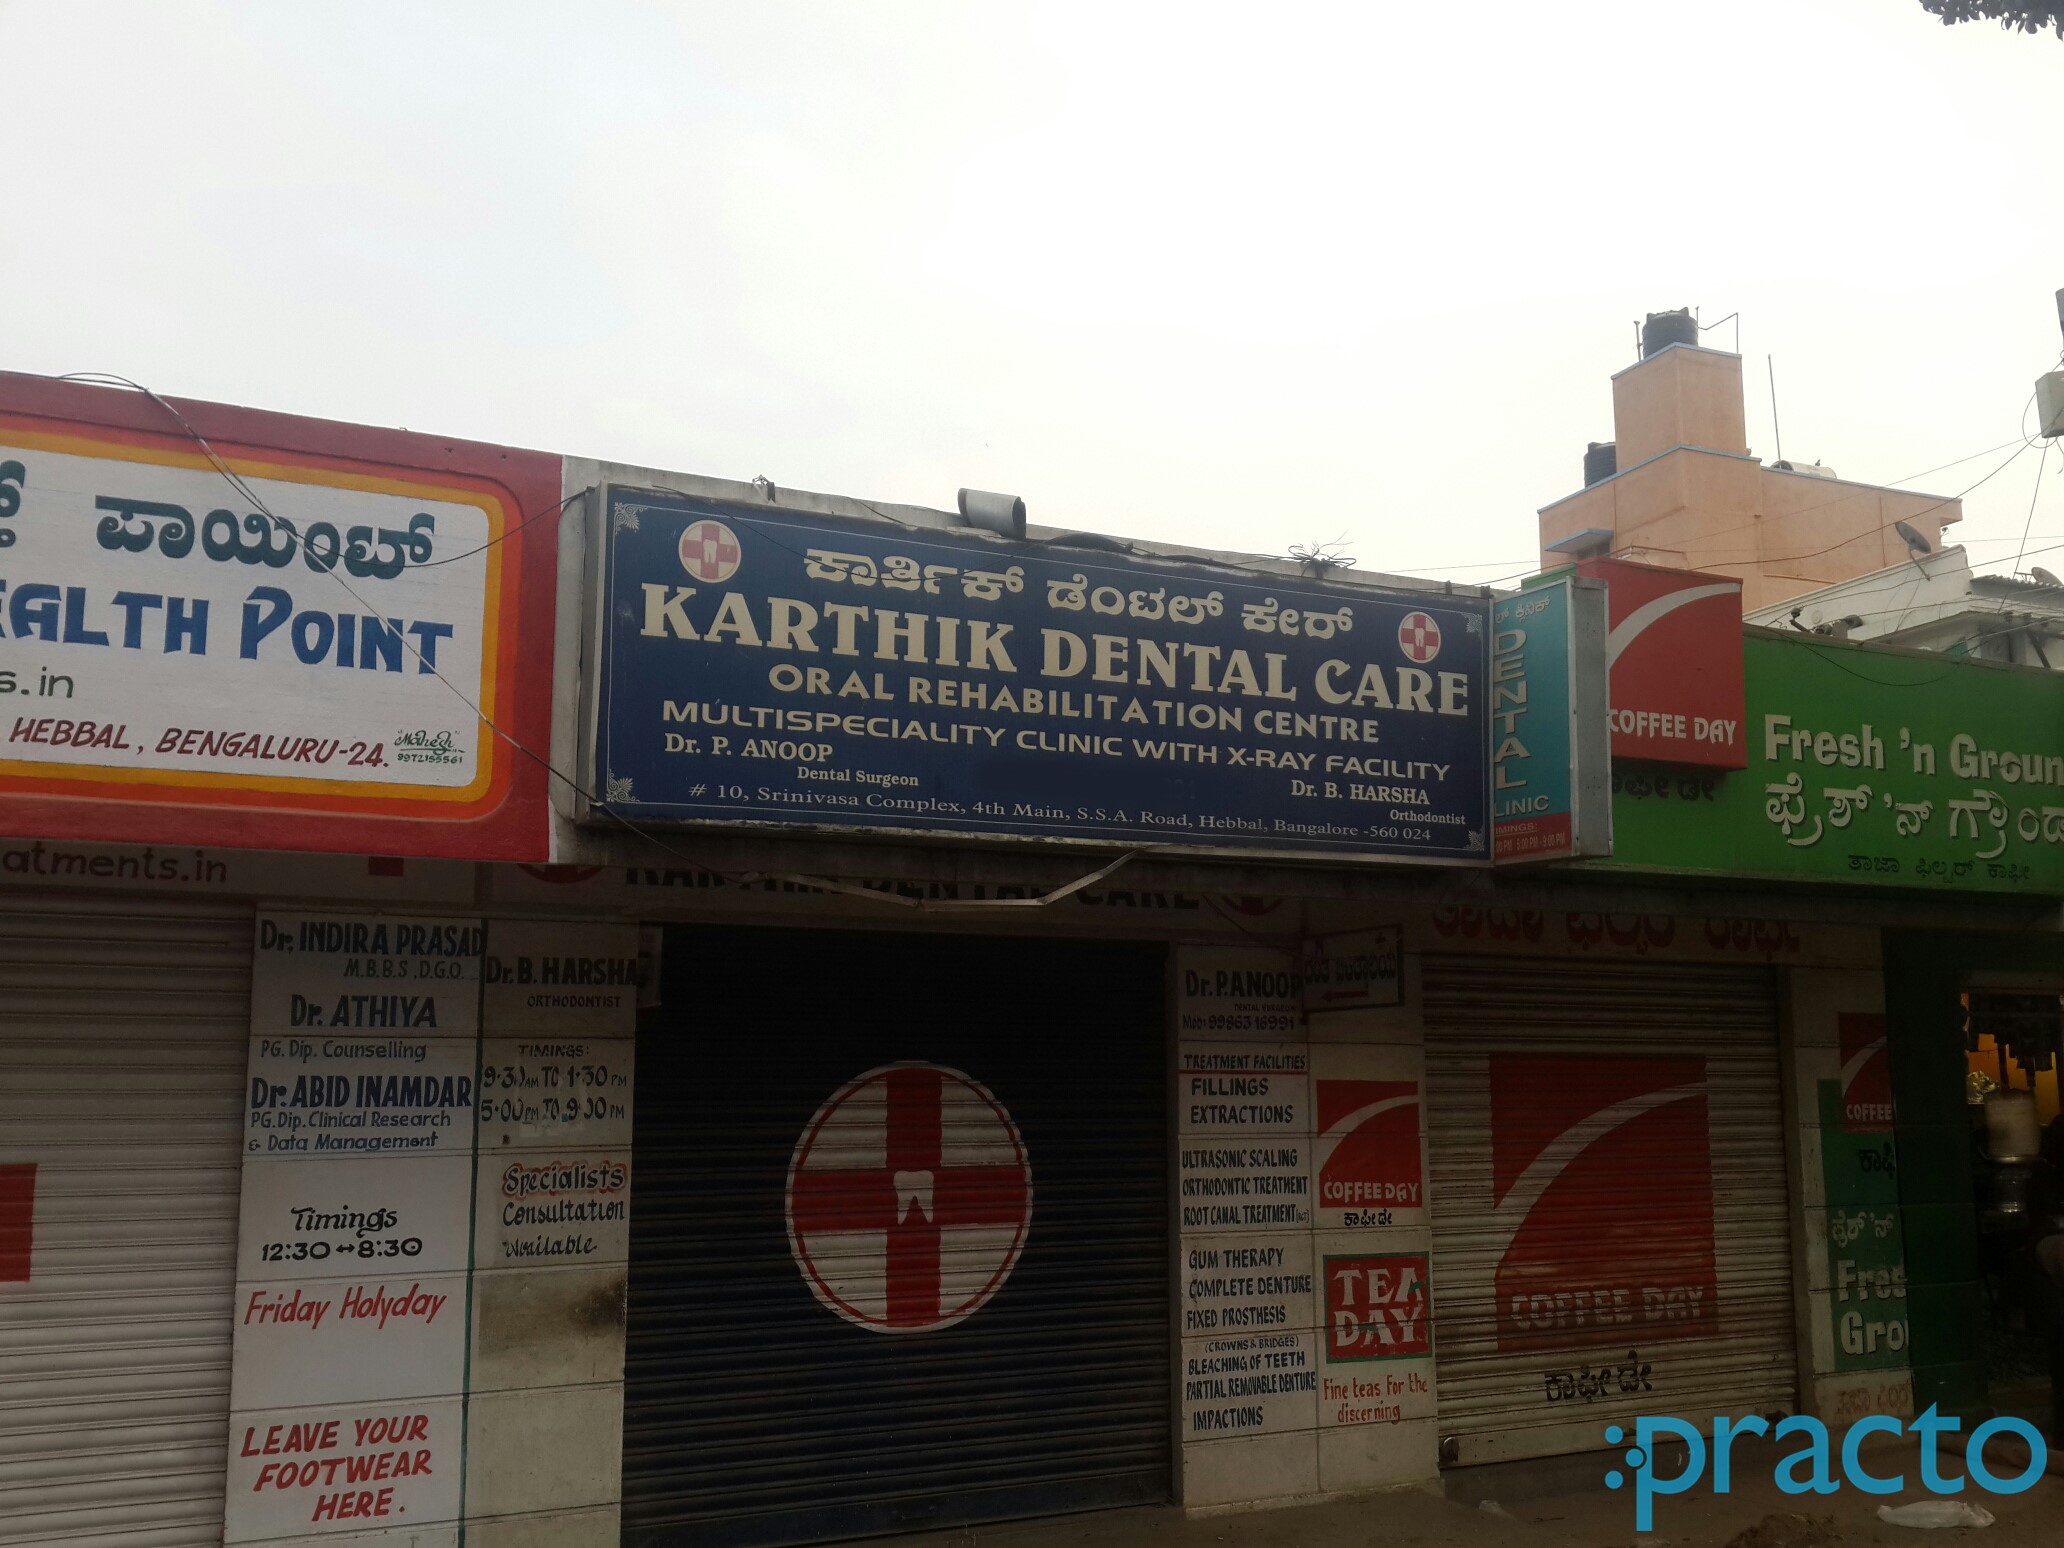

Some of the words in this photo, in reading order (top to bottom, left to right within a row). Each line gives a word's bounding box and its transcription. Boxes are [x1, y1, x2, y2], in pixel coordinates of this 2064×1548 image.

[95, 495, 435, 579] ಪಾಯಿಂಟ್
[239, 586, 453, 674] POINT
[1241, 597, 1353, 639] ಕೇರ್
[640, 583, 1017, 672] KARTHIK
[1040, 627, 1297, 701] DENTAL
[1315, 659, 1468, 716] CARE
[769, 663, 895, 700] ORAL
[909, 677, 1242, 731] REHABILITATION
[1254, 709, 1379, 743] CENTRE
[1494, 629, 1531, 790] DENTAL
[662, 700, 1006, 747] MULTISPECIALITY
[1016, 729, 1122, 757] CLINIC
[1133, 738, 1217, 764] WITH
[1227, 747, 1316, 771] X-RAY
[1325, 756, 1450, 781] FACILITY
[1609, 709, 1687, 738] COFFEE
[1694, 717, 1737, 746] DAY
[9, 716, 143, 756] HEBBAL,
[155, 727, 390, 769] BENGALURU-24.
[664, 733, 701, 754] Dr.
[712, 737, 732, 756] P.
[741, 740, 833, 762] ANOOP
[1765, 714, 1884, 770] Fresh
[797, 766, 851, 783] Dental
[855, 769, 920, 787] Surgeon
[1291, 779, 1317, 797] Dr.
[1325, 782, 1342, 799] B.
[1349, 784, 1430, 805] HARSHA
[717, 785, 750, 801] 10,
[757, 786, 860, 806] Srinivasa
[865, 792, 967, 815] Complex,
[971, 800, 1005, 816] 4th
[1013, 803, 1071, 821] Main,
[1077, 806, 1133, 823] S.S.A.
[1141, 811, 1194, 829] Road,
[1199, 814, 1269, 833] Hebbal,
[1274, 819, 1358, 839] Bangalore
[1402, 826, 1431, 841] 024
[1390, 809, 1467, 826] Orthodontist
[260, 919, 293, 951] Dr.
[299, 921, 389, 955] INDIRA
[396, 924, 486, 957] PRASAD
[541, 957, 638, 986] HARSHA
[290, 994, 322, 1026] Dr.
[330, 995, 437, 1028] ATHIYA
[527, 995, 621, 1008] ORTHODONTIST
[322, 1040, 427, 1063] Counselling
[518, 1044, 590, 1058] TIMINGS:
[1184, 1054, 1250, 1069] TREATMENT
[1253, 1055, 1306, 1069] FACILITIES
[356, 1075, 472, 1107] INAMDAR
[611, 1074, 627, 1087] PM
[1191, 1077, 1269, 1096] FILLINGS
[371, 1111, 451, 1127] Research
[610, 1105, 624, 1119] PM
[1191, 1104, 1293, 1124] EXTRACTIONS
[1846, 1104, 1893, 1121] COFFEE
[268, 1135, 308, 1151] Data
[315, 1131, 438, 1152] Management
[1182, 1149, 1247, 1168] ULTRASONIC
[1249, 1149, 1297, 1167] SCALING
[506, 1163, 624, 1196] Specialists
[1182, 1177, 1251, 1196] ORTHODONTIC
[1253, 1176, 1308, 1194] TREATMENT
[1324, 1181, 1382, 1203] COFFEE
[1384, 1182, 1419, 1202] DAY
[291, 1205, 398, 1238] Timings
[503, 1198, 625, 1226] Consultation
[1184, 1206, 1209, 1226] ROOT
[1211, 1205, 1241, 1225] CANAL
[1189, 1250, 1218, 1271] GUM
[1223, 1247, 1284, 1268] THERAPY
[1189, 1277, 1254, 1299] COMPLETE
[1257, 1275, 1311, 1295] DENTURE
[1333, 1267, 1423, 1306] TEA
[244, 1289, 331, 1329] Friday
[338, 1283, 447, 1329] Holyday
[1187, 1310, 1217, 1330] FIXED
[1222, 1305, 1286, 1327] PROSTHESIS
[1511, 1287, 1633, 1330] COFFEE
[1642, 1286, 1704, 1321] DAY
[1333, 1306, 1424, 1350] DAY
[1840, 1311, 1909, 1355] Gro
[1188, 1356, 1248, 1375] BLEACHING
[1250, 1356, 1261, 1370] OF
[1264, 1351, 1305, 1368] TEETH
[1186, 1379, 1226, 1400] PARTIAL
[1228, 1374, 1278, 1398] REMOVABLE
[1279, 1371, 1316, 1393] DENTURE
[1323, 1378, 1348, 1400] Fine
[1352, 1377, 1381, 1398] teas
[1408, 1372, 1428, 1393] the
[1193, 1406, 1263, 1430] IMPACTIONS
[1338, 1400, 1400, 1425] discerning
[240, 1420, 340, 1457] LEAVE
[354, 1414, 429, 1447] YOUR
[253, 1448, 433, 1492] FOOTWEAR
